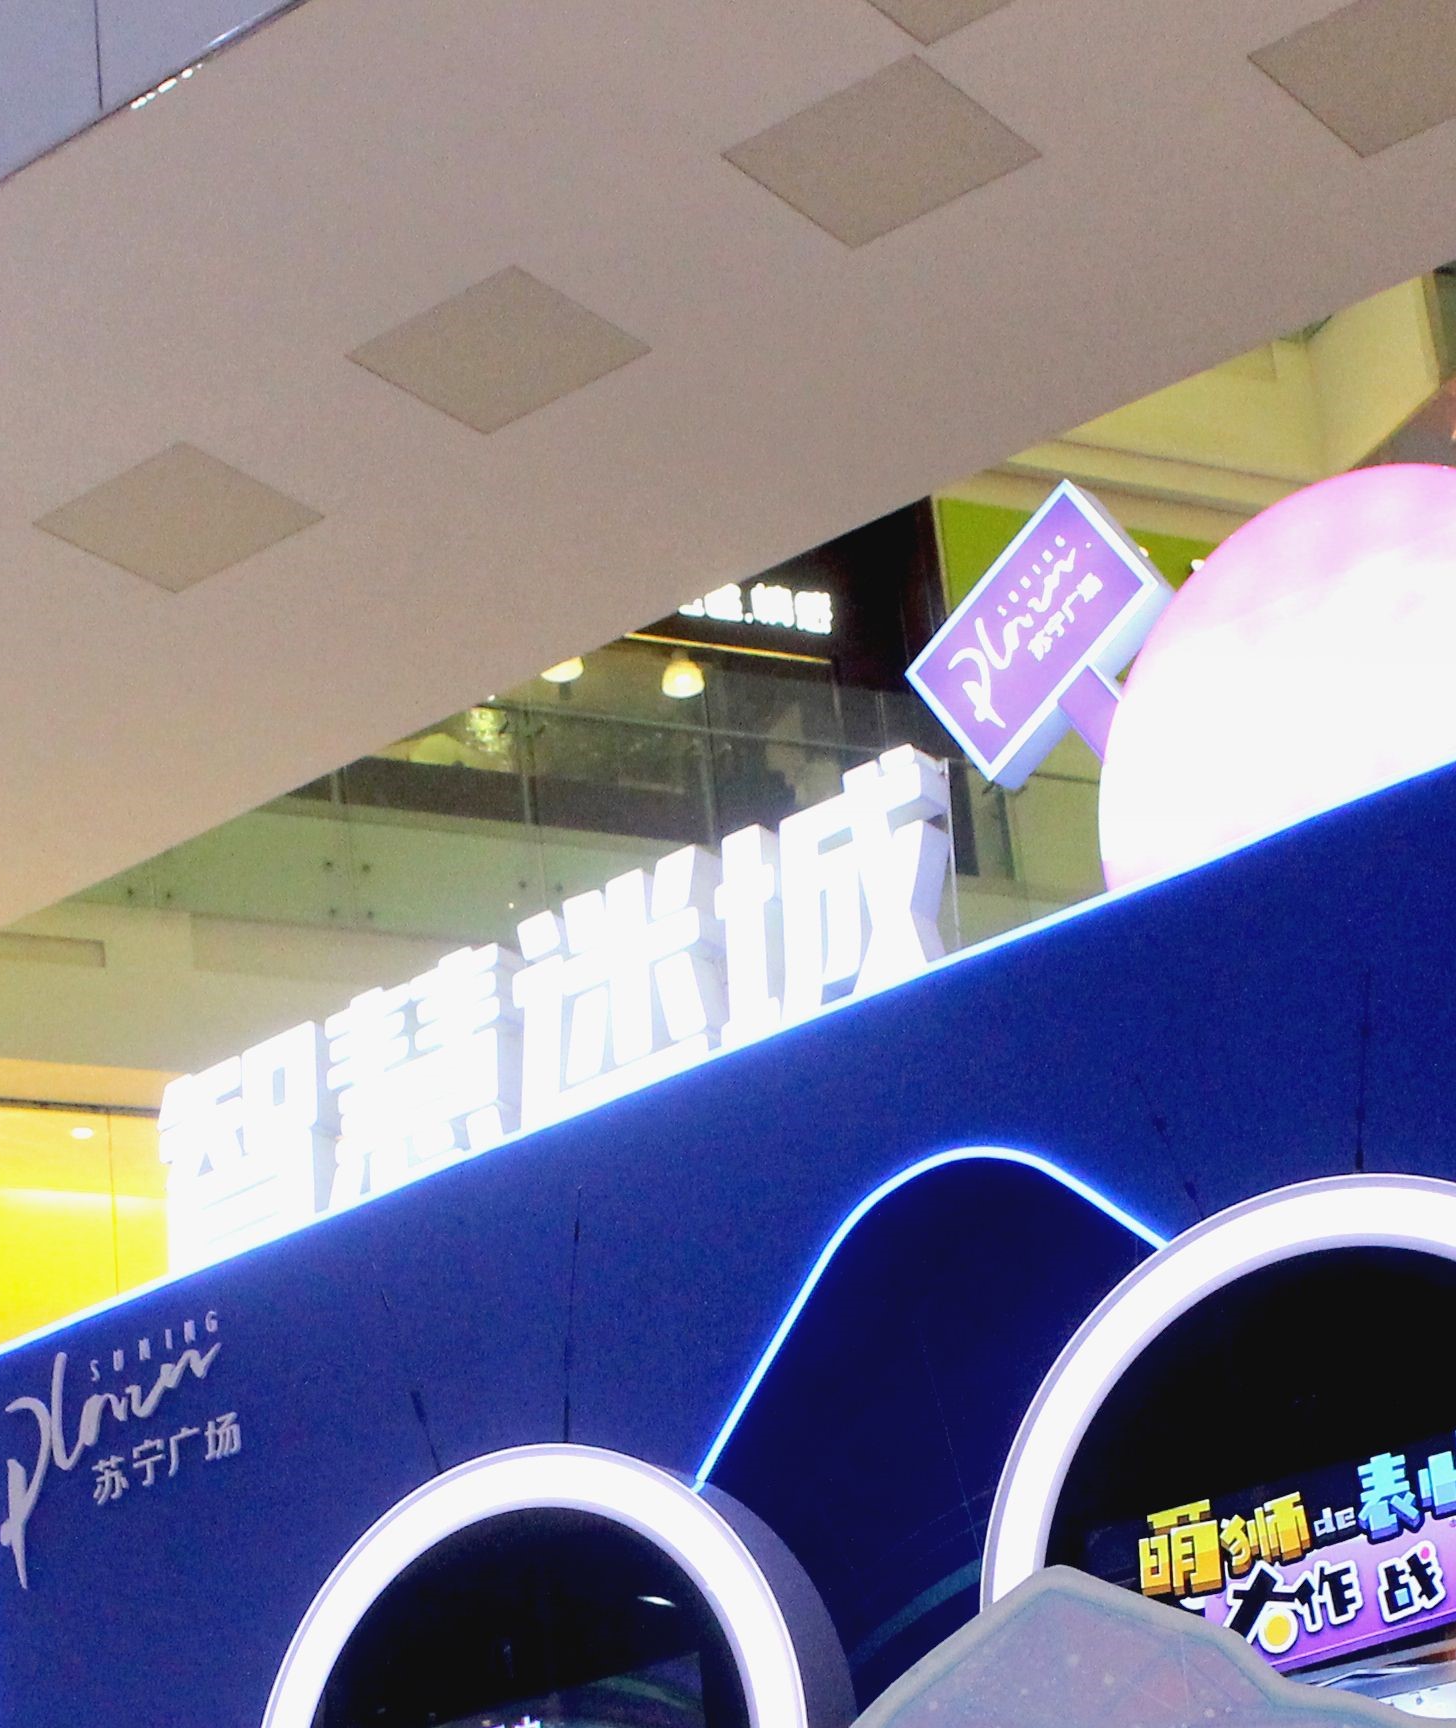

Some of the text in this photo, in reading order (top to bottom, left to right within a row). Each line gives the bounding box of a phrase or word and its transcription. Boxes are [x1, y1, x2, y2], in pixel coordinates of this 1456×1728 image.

[90, 1310, 219, 1382] SUNING
[91, 1411, 242, 1506] 苏宁广场
